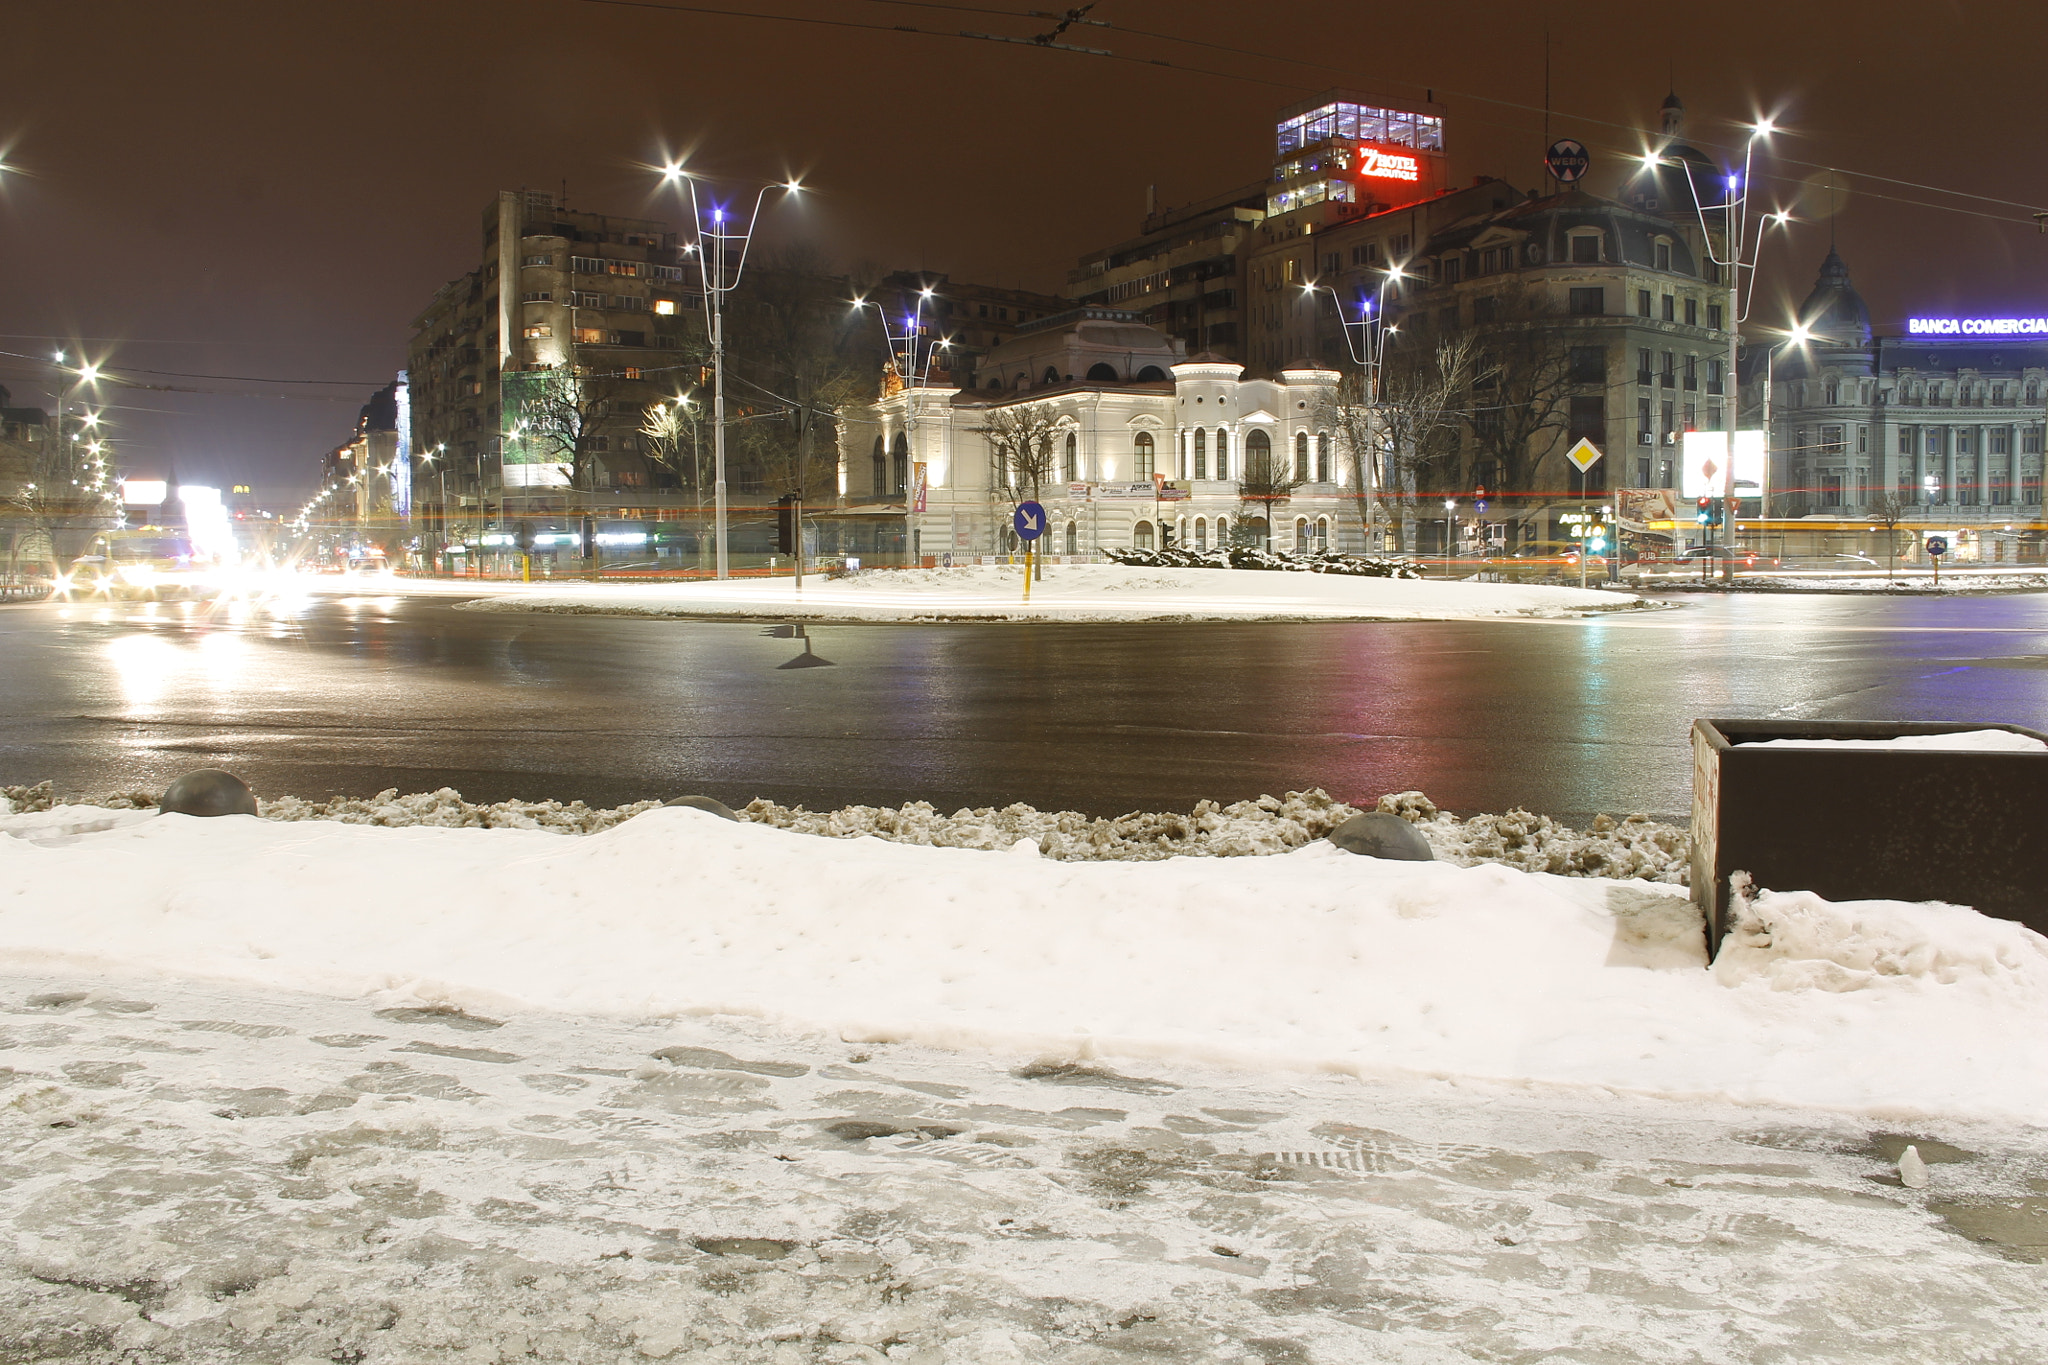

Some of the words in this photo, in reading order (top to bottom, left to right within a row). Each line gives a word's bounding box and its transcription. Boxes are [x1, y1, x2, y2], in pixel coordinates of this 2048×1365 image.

[1377, 153, 1418, 171] HOTEL
[1909, 318, 1960, 334] BANCA
[1962, 318, 2048, 334] COMERCIA
[513, 414, 563, 431] MARE
[1639, 551, 1657, 562] PUB
